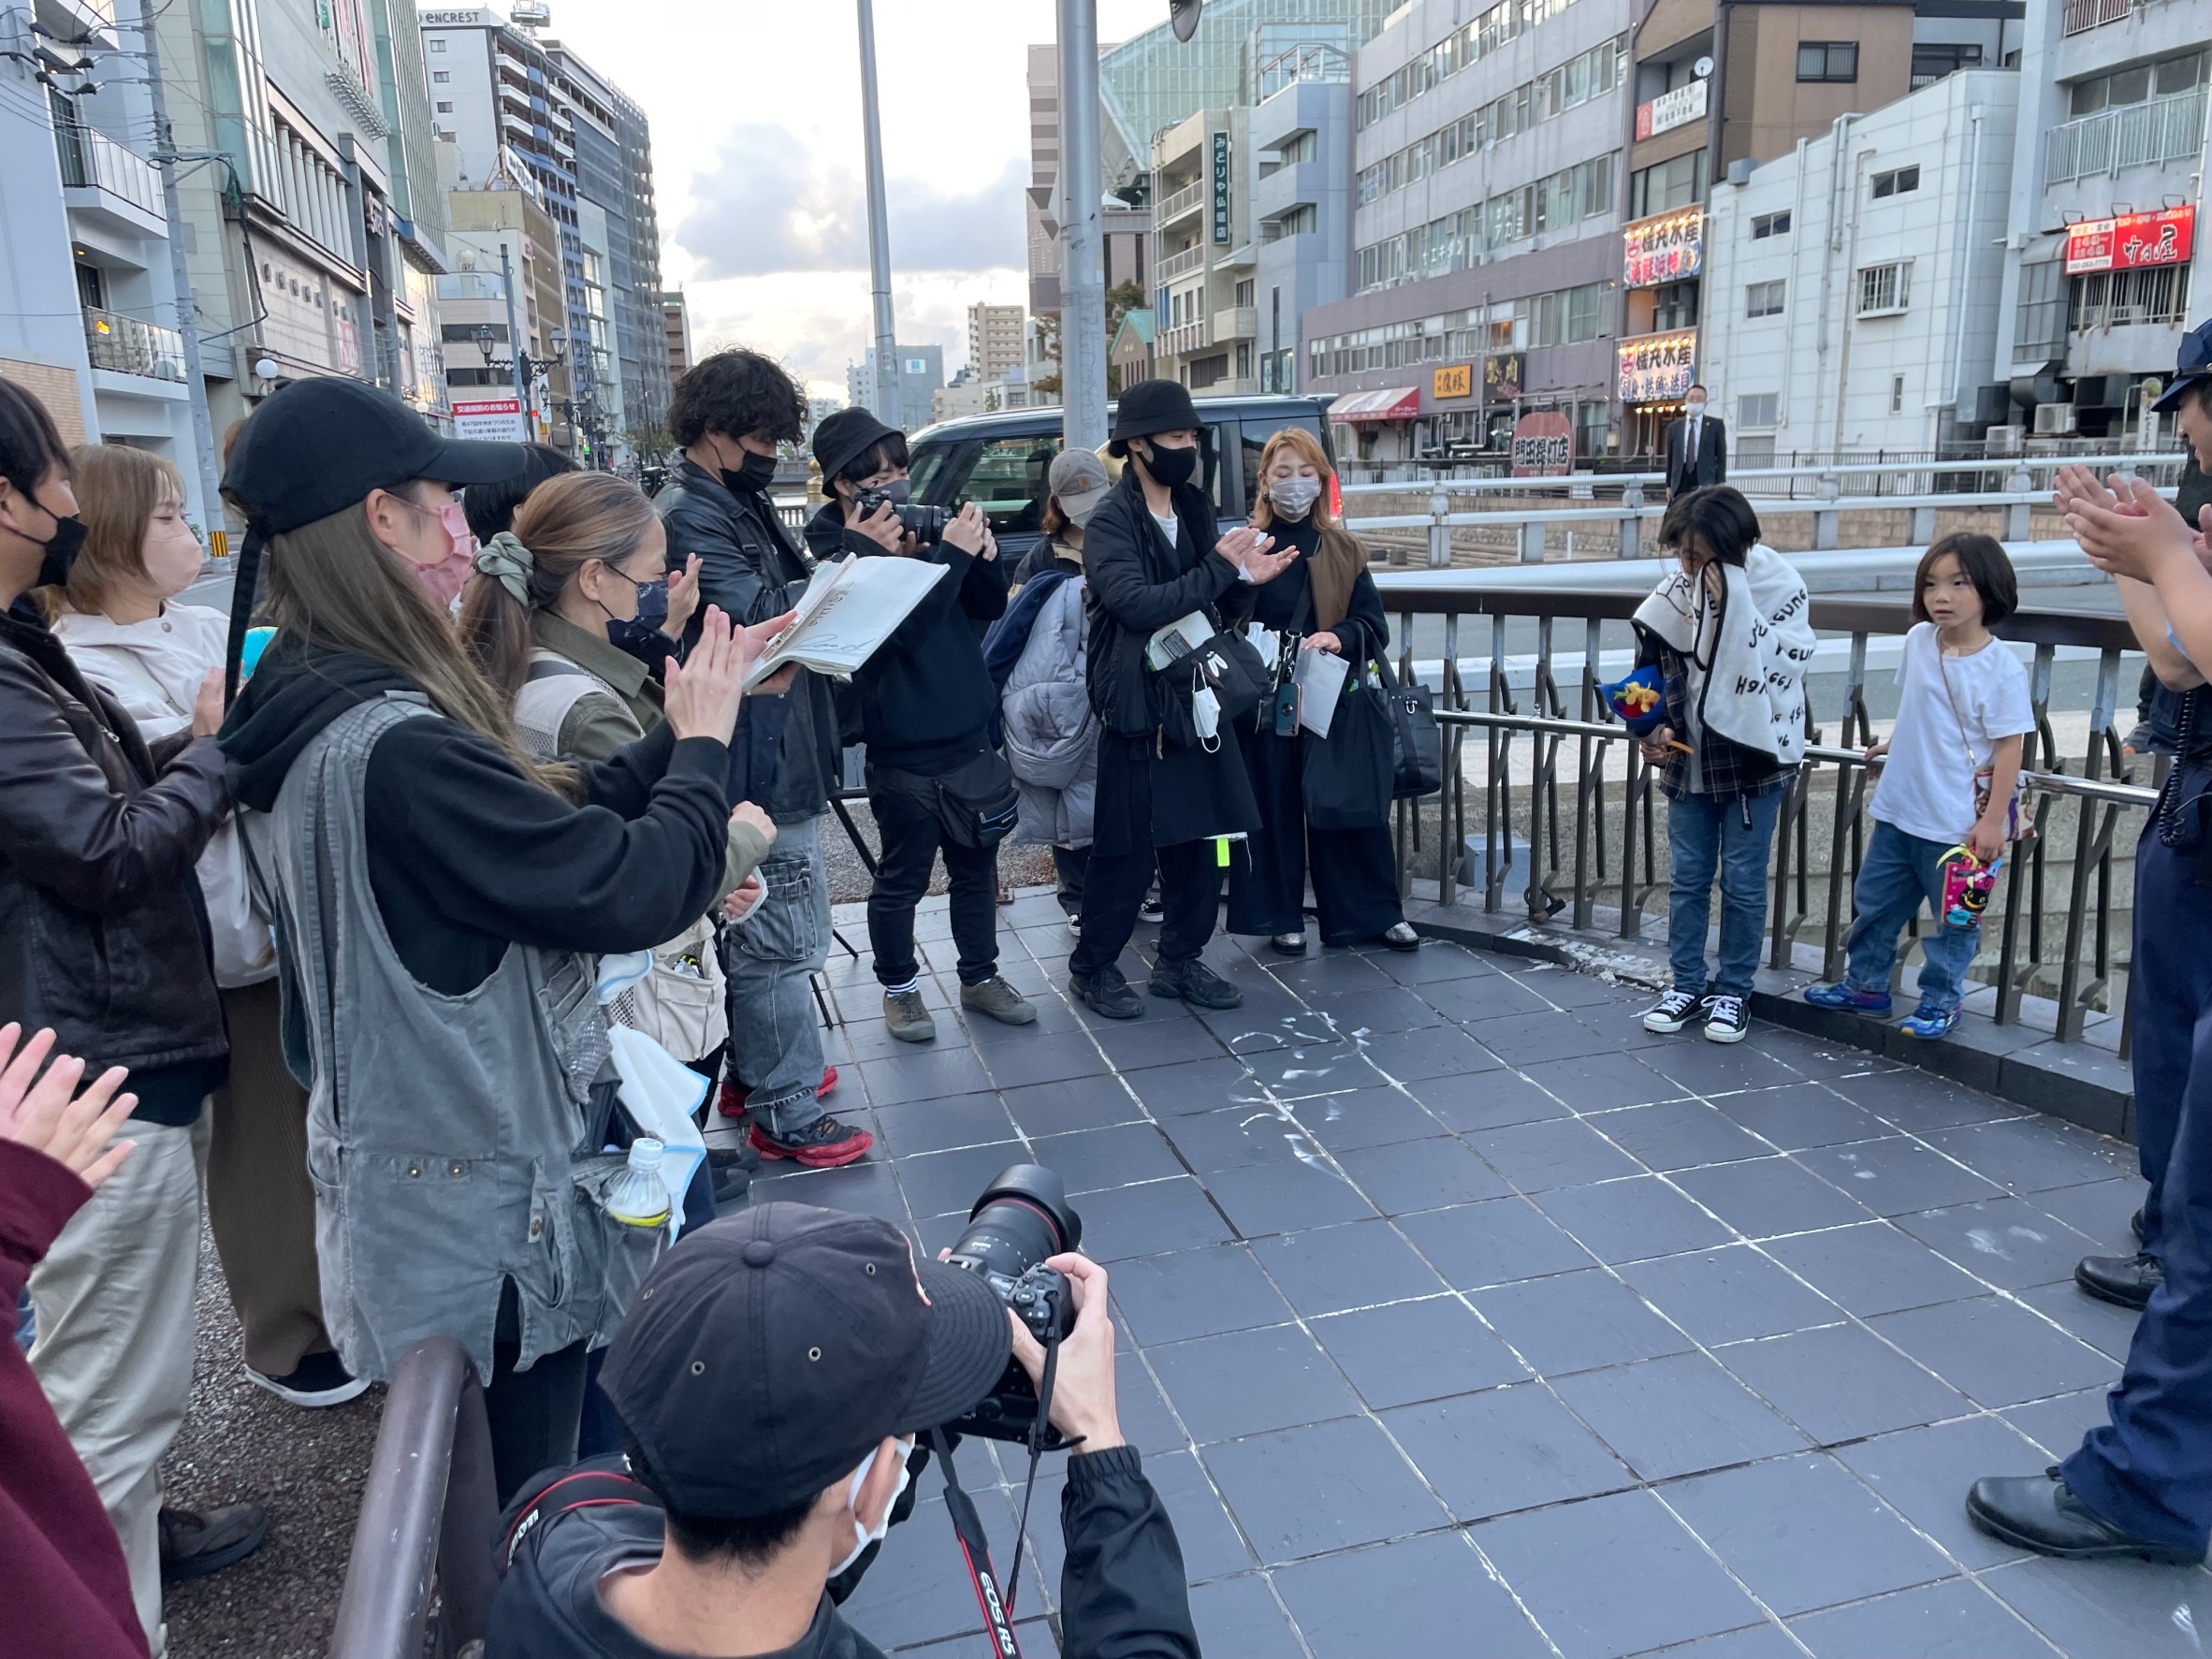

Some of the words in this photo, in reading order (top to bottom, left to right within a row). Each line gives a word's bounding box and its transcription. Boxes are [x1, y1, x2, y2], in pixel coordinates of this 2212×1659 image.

[1637, 344, 1691, 371] 磯丸水産
[981, 1571, 1006, 1624] EOS
[997, 1626, 1016, 1655] R5
